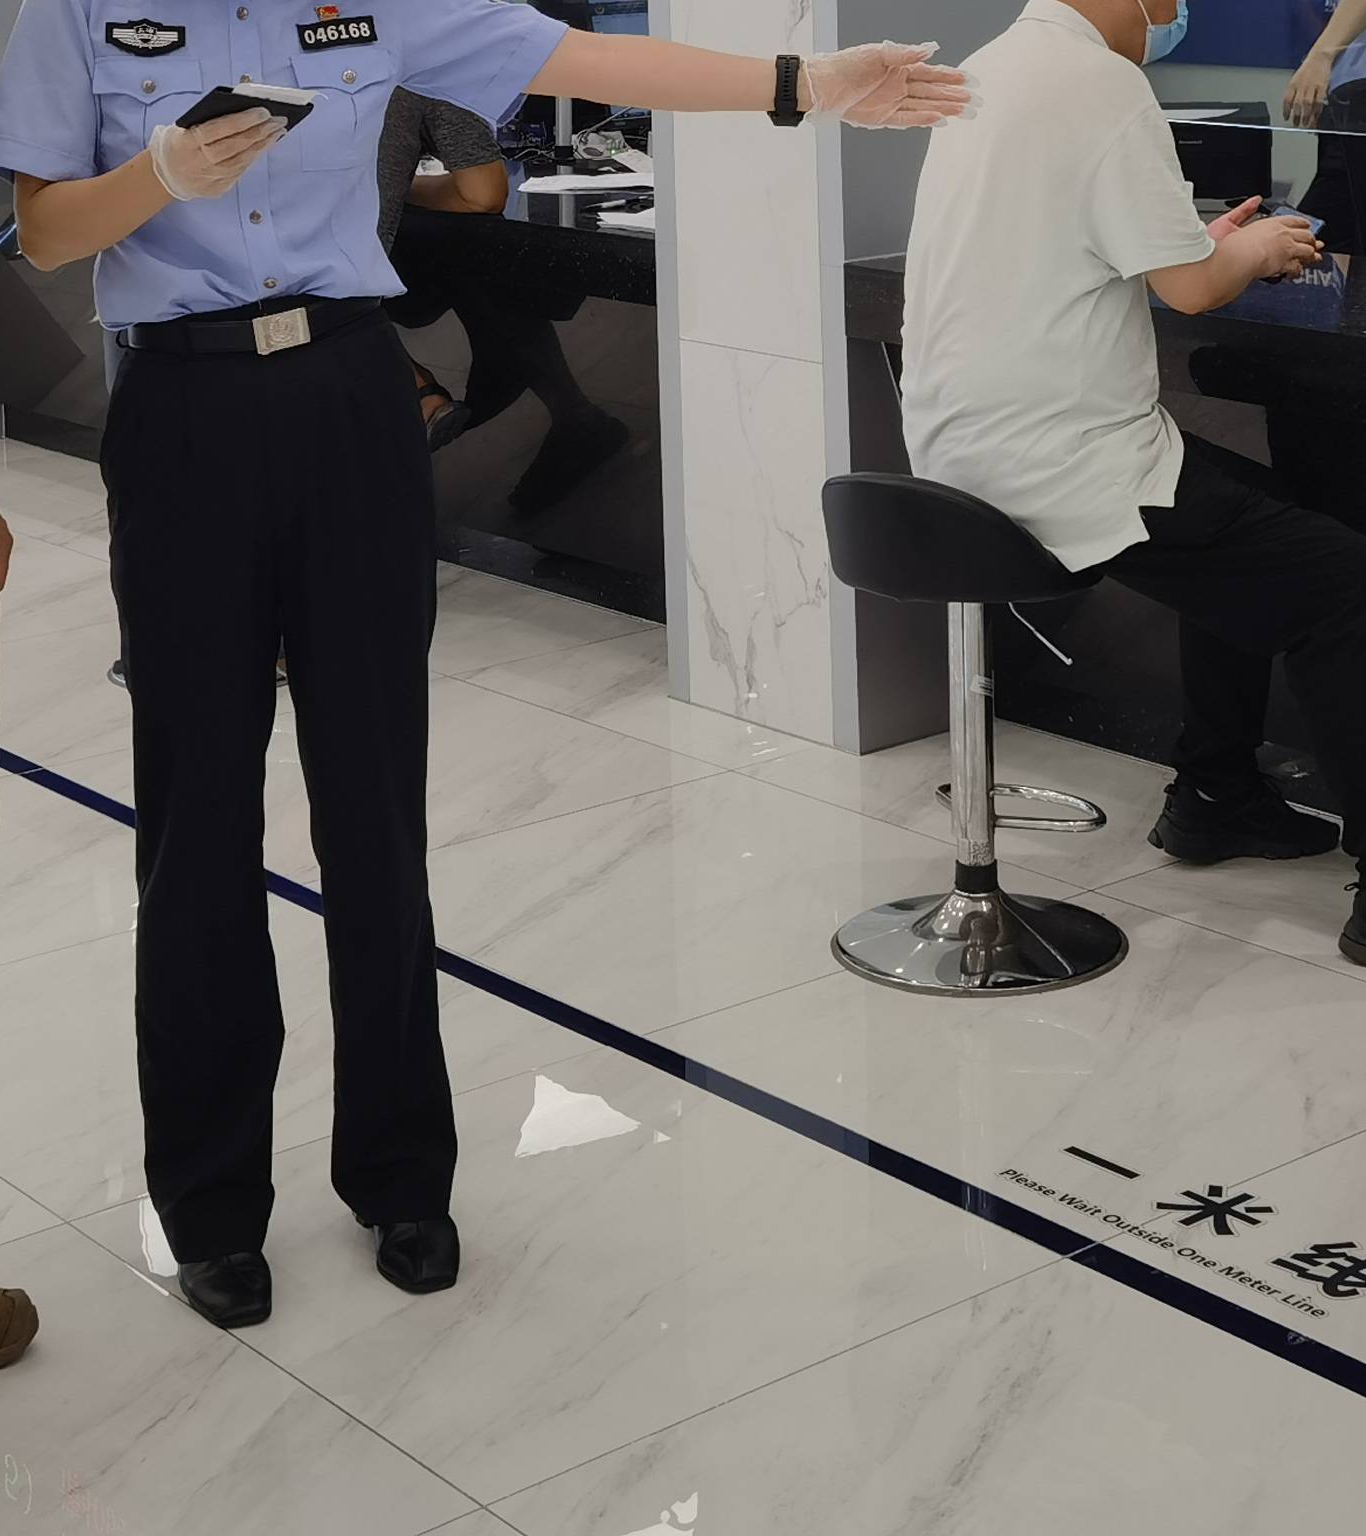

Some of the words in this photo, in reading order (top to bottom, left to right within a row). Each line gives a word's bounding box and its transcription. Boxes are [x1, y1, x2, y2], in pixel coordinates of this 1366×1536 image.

[304, 22, 370, 44] 046168
[1000, 1169, 1056, 1196] Please
[1059, 1194, 1102, 1215] Wait
[1103, 1215, 1174, 1249] Outside
[1177, 1248, 1217, 1268] One
[1219, 1266, 1281, 1296] Meter
[1281, 1294, 1325, 1317] Line
